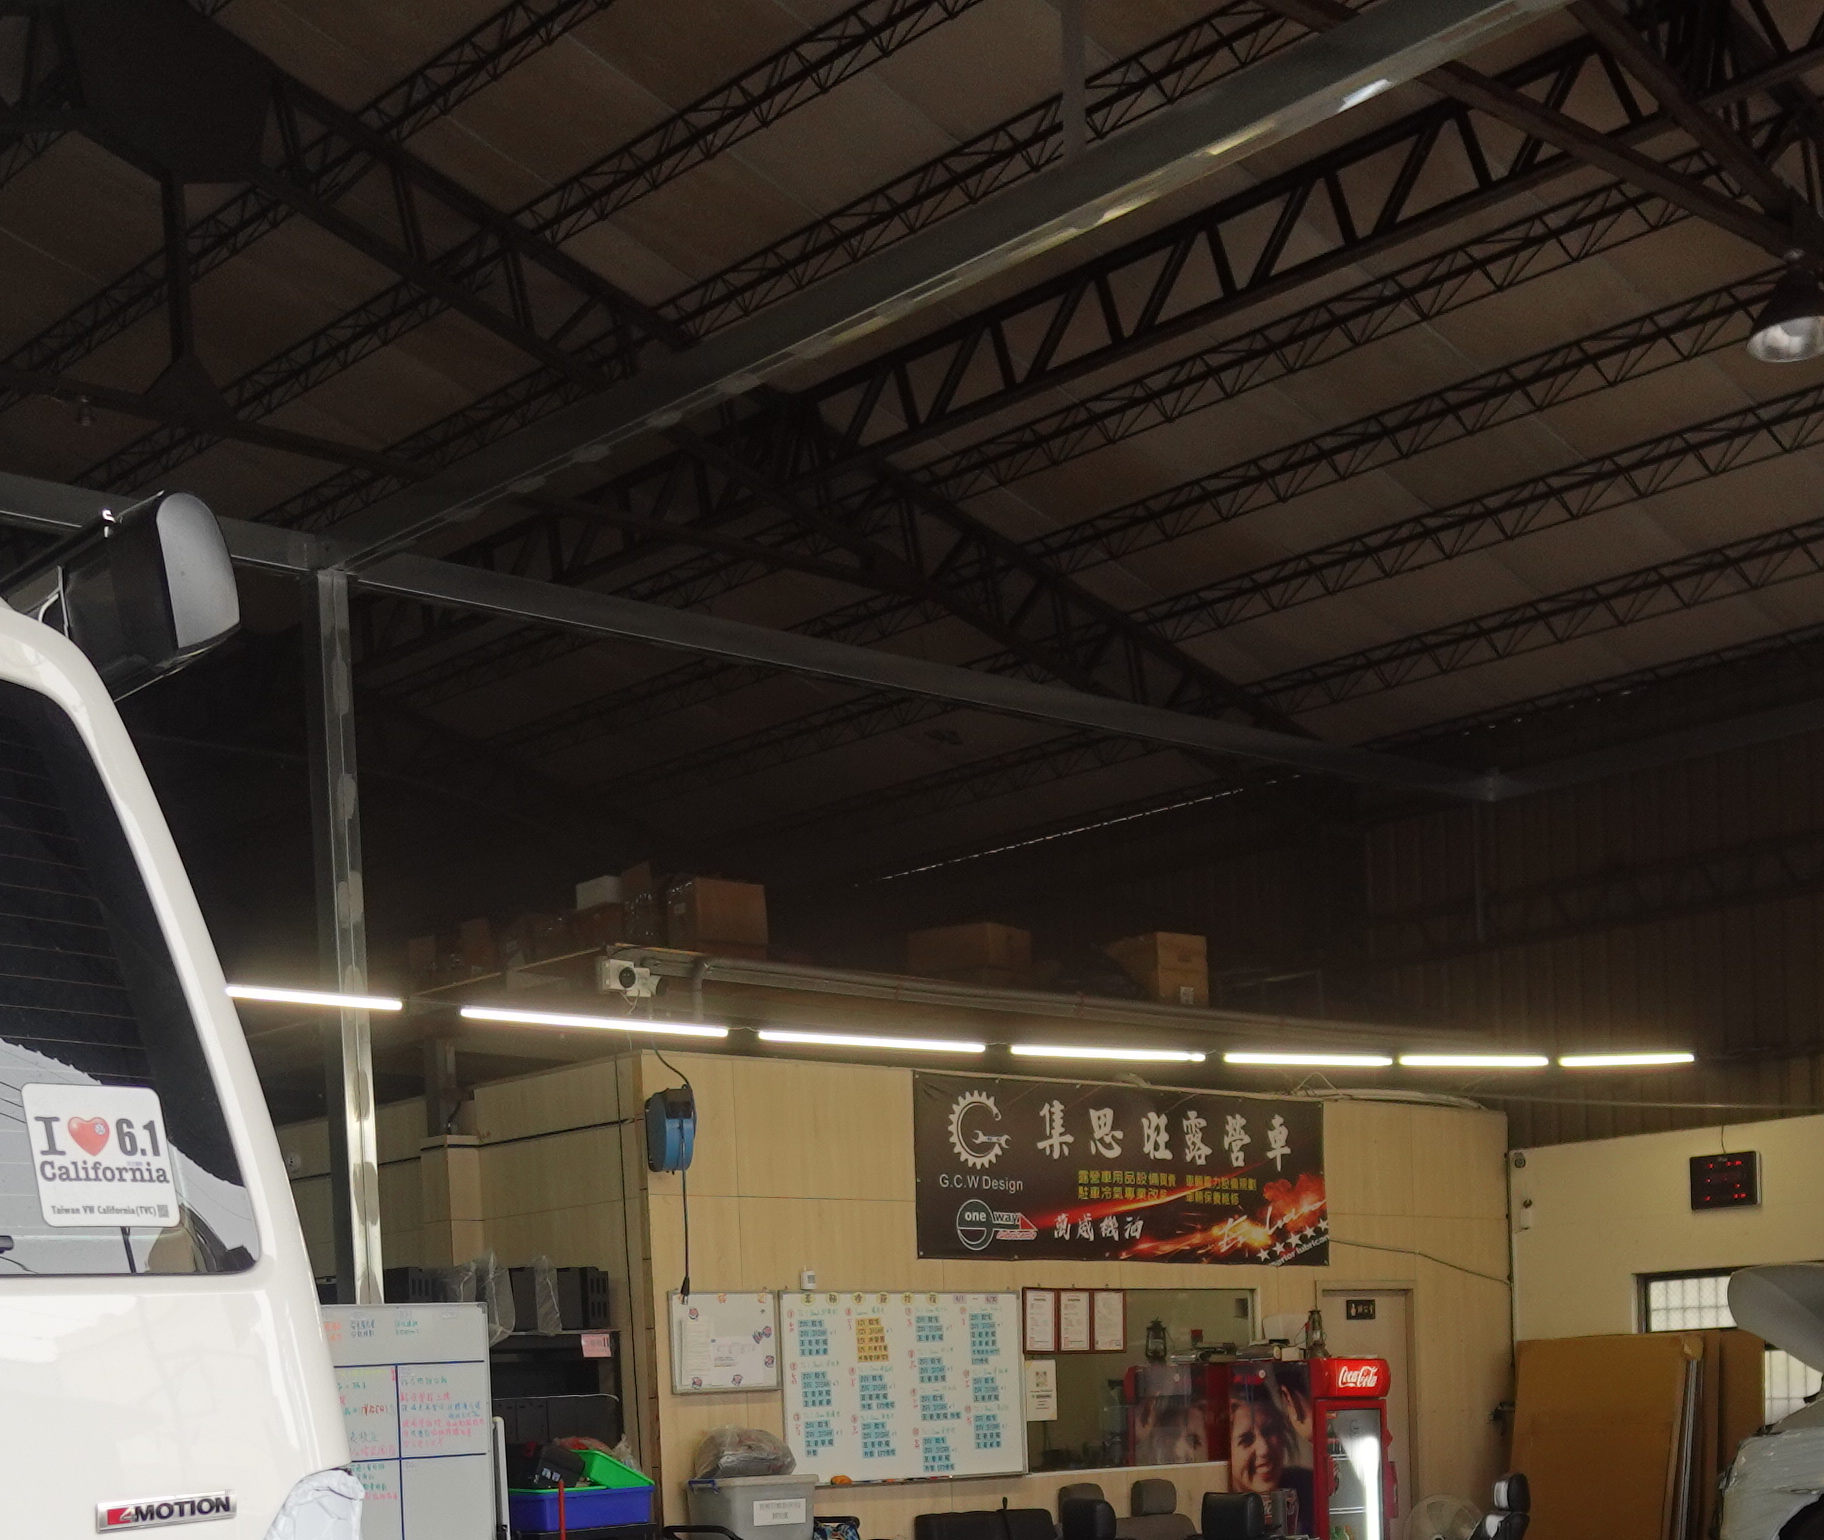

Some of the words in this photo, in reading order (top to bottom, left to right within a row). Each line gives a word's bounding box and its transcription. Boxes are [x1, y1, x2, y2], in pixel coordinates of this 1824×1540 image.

[34, 1116, 67, 1156] I
[115, 1117, 161, 1157] 6.1
[1036, 1099, 1292, 1172] 集思旺露營車
[39, 1159, 170, 1184] California
[939, 1173, 980, 1189] G.C.W
[982, 1175, 1023, 1194] Design
[51, 1204, 81, 1216] Taiwan
[964, 1211, 987, 1222] one
[993, 1212, 1020, 1225] way
[1338, 1365, 1380, 1388] Coca-Cola
[119, 1496, 231, 1523] 4MOTION
